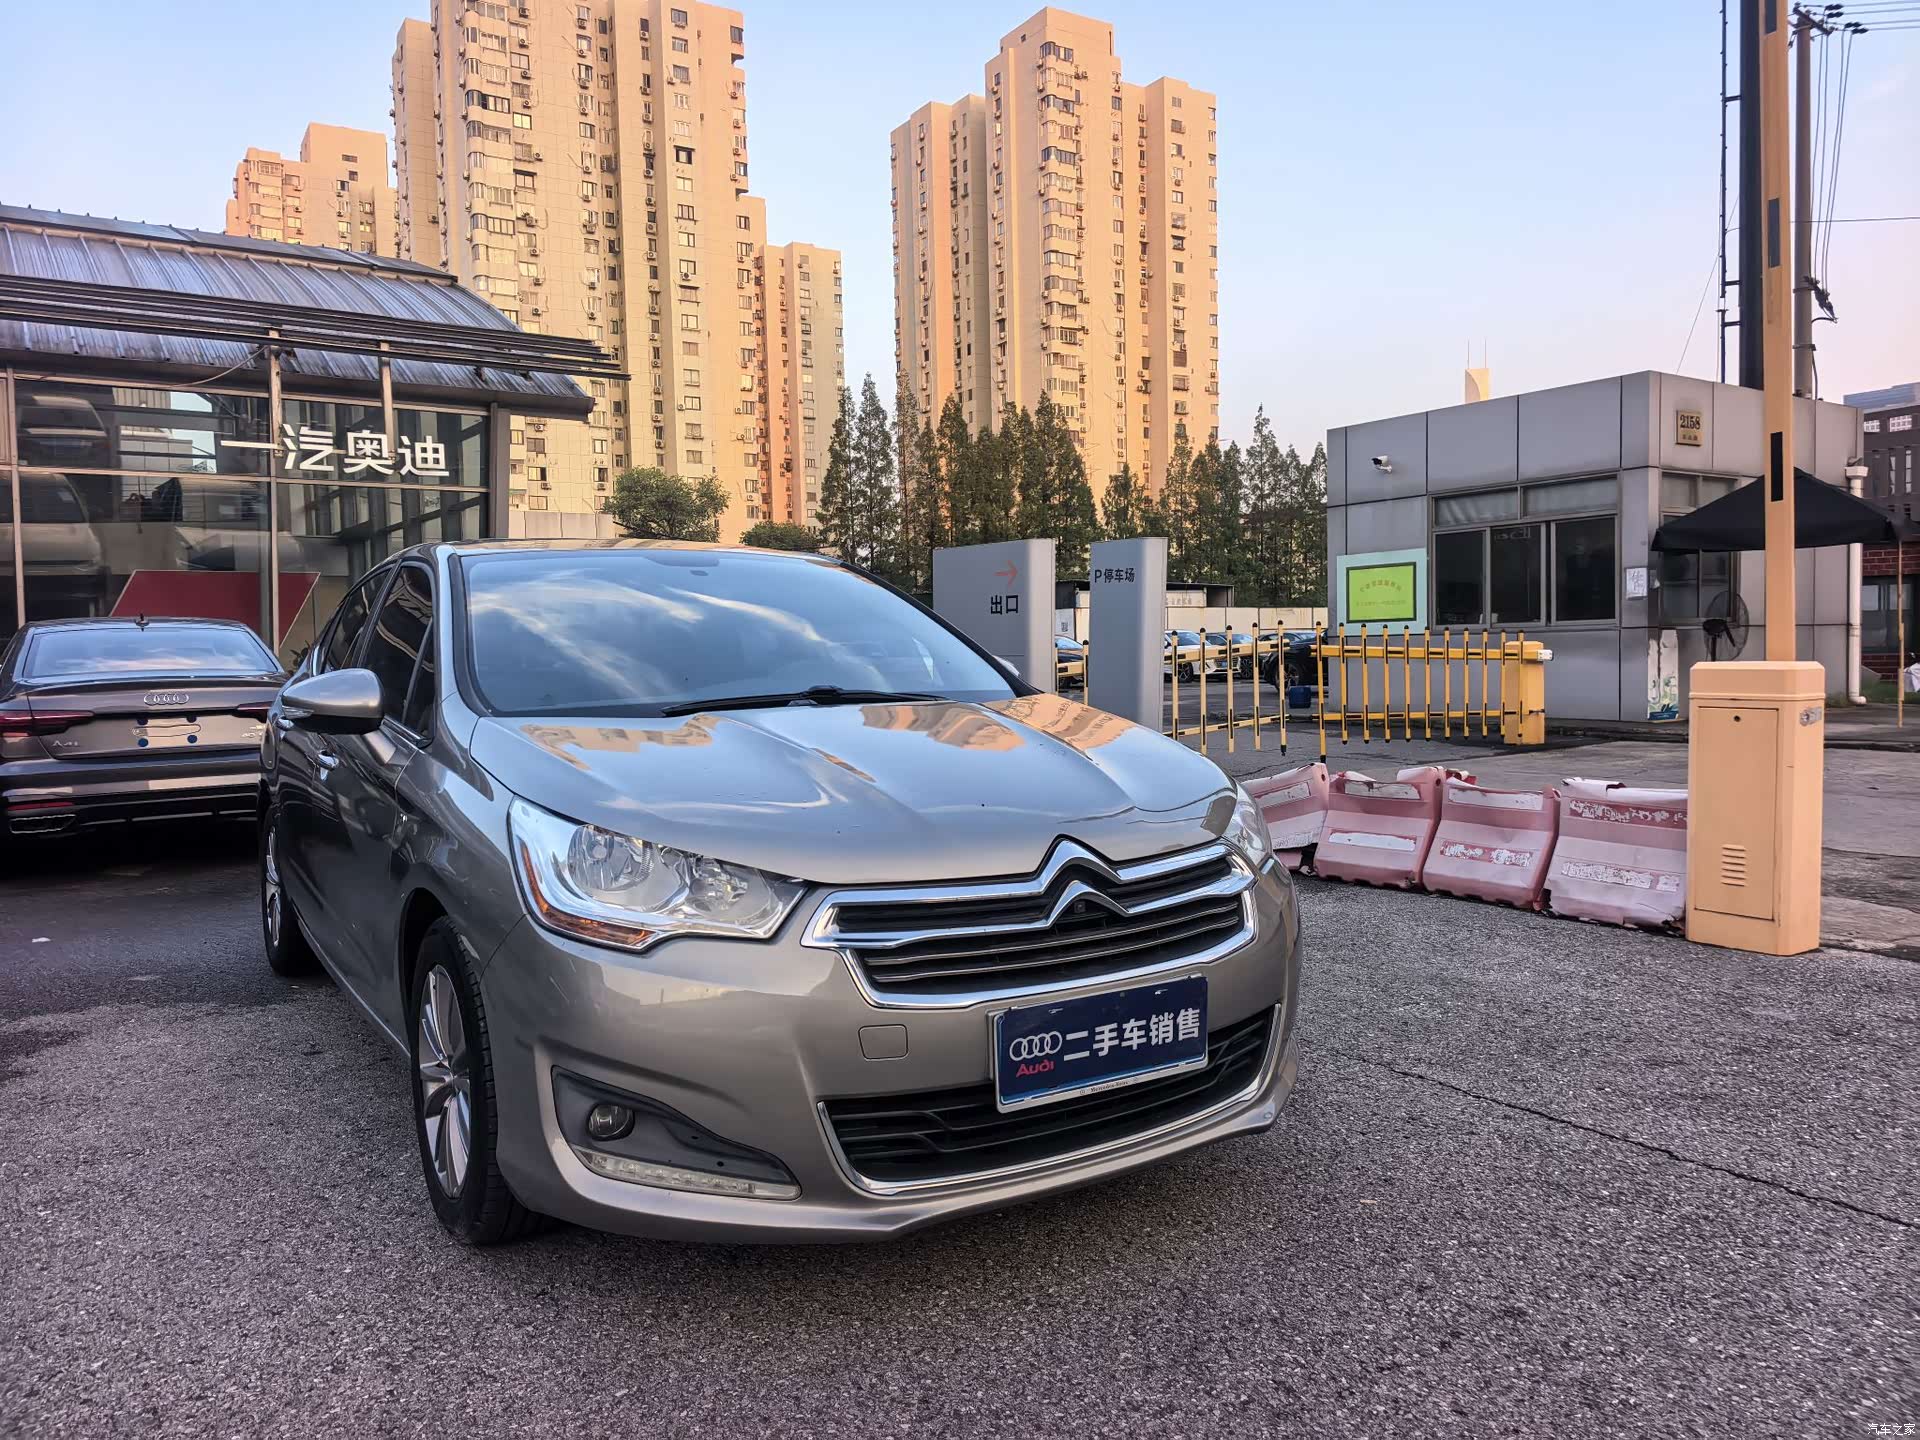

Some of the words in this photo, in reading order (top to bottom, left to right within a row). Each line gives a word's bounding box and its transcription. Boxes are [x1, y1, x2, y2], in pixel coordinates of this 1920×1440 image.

[1680, 415, 1701, 430] 2158
[220, 423, 449, 477] 一汽奥迪
[990, 594, 1019, 615] 出口
[1063, 1007, 1201, 1062] 二手车销售
[1016, 1059, 1055, 1078] Audi
